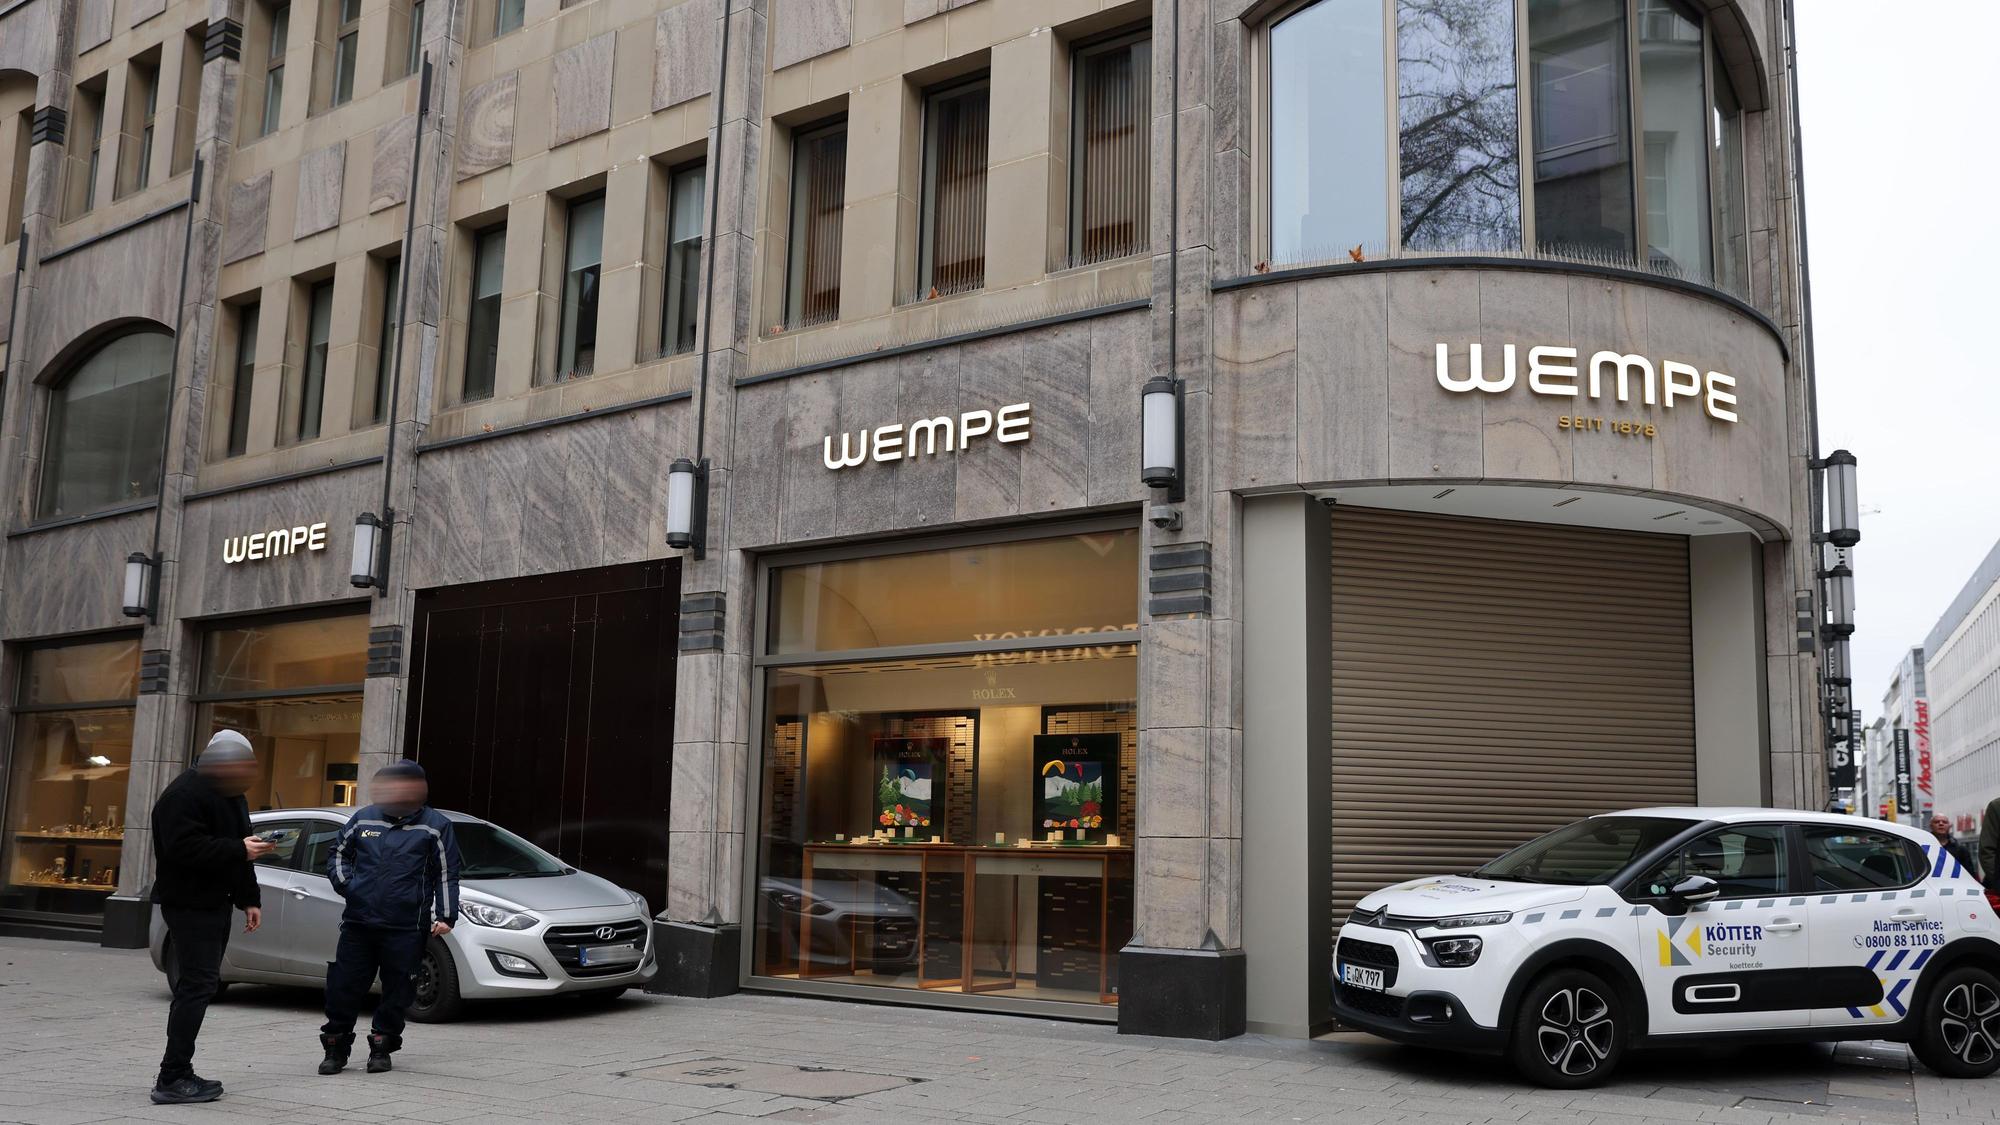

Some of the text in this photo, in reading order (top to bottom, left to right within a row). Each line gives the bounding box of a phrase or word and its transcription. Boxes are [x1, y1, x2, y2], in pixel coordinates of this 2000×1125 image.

[1436, 343, 1738, 423] WEMPE
[1559, 415, 1656, 437] SEIT 1878
[824, 402, 1030, 470] WEMPE
[223, 522, 327, 564] WEMPE
[973, 687, 1016, 700] ROLEX
[1706, 922, 1762, 941] KÖTTER
[1865, 933, 1945, 948] 0800 88 110 88
[1708, 943, 1757, 957] Security
[1730, 961, 1763, 969] koetter.de
[1365, 969, 1380, 987] 797
